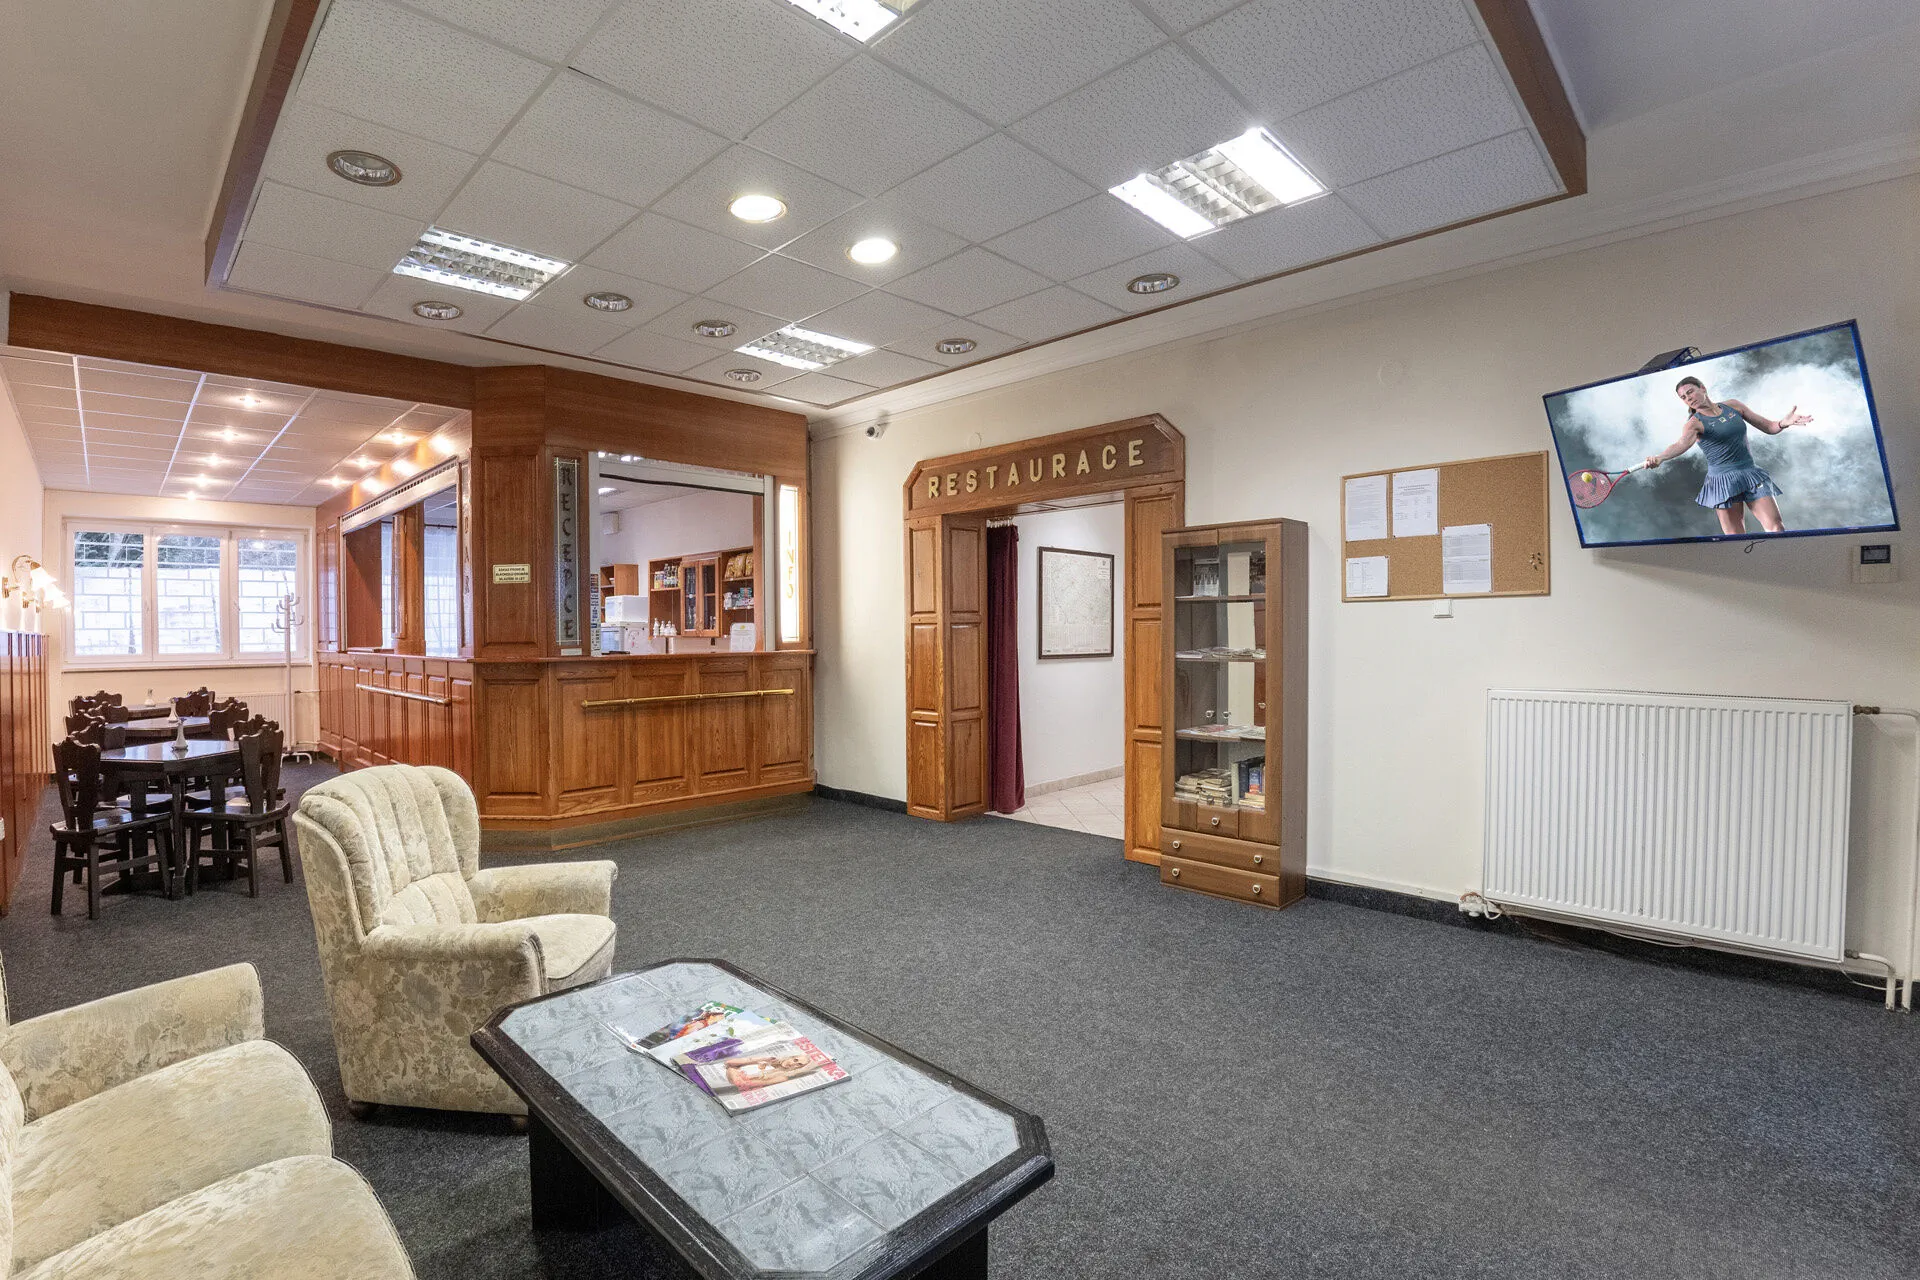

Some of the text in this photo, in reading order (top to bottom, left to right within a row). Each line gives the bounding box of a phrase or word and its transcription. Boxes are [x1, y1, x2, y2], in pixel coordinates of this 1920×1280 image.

[928, 439, 1144, 499] RESTAURACE
[560, 467, 575, 639] RECEPCE
[787, 530, 795, 599] INFO
